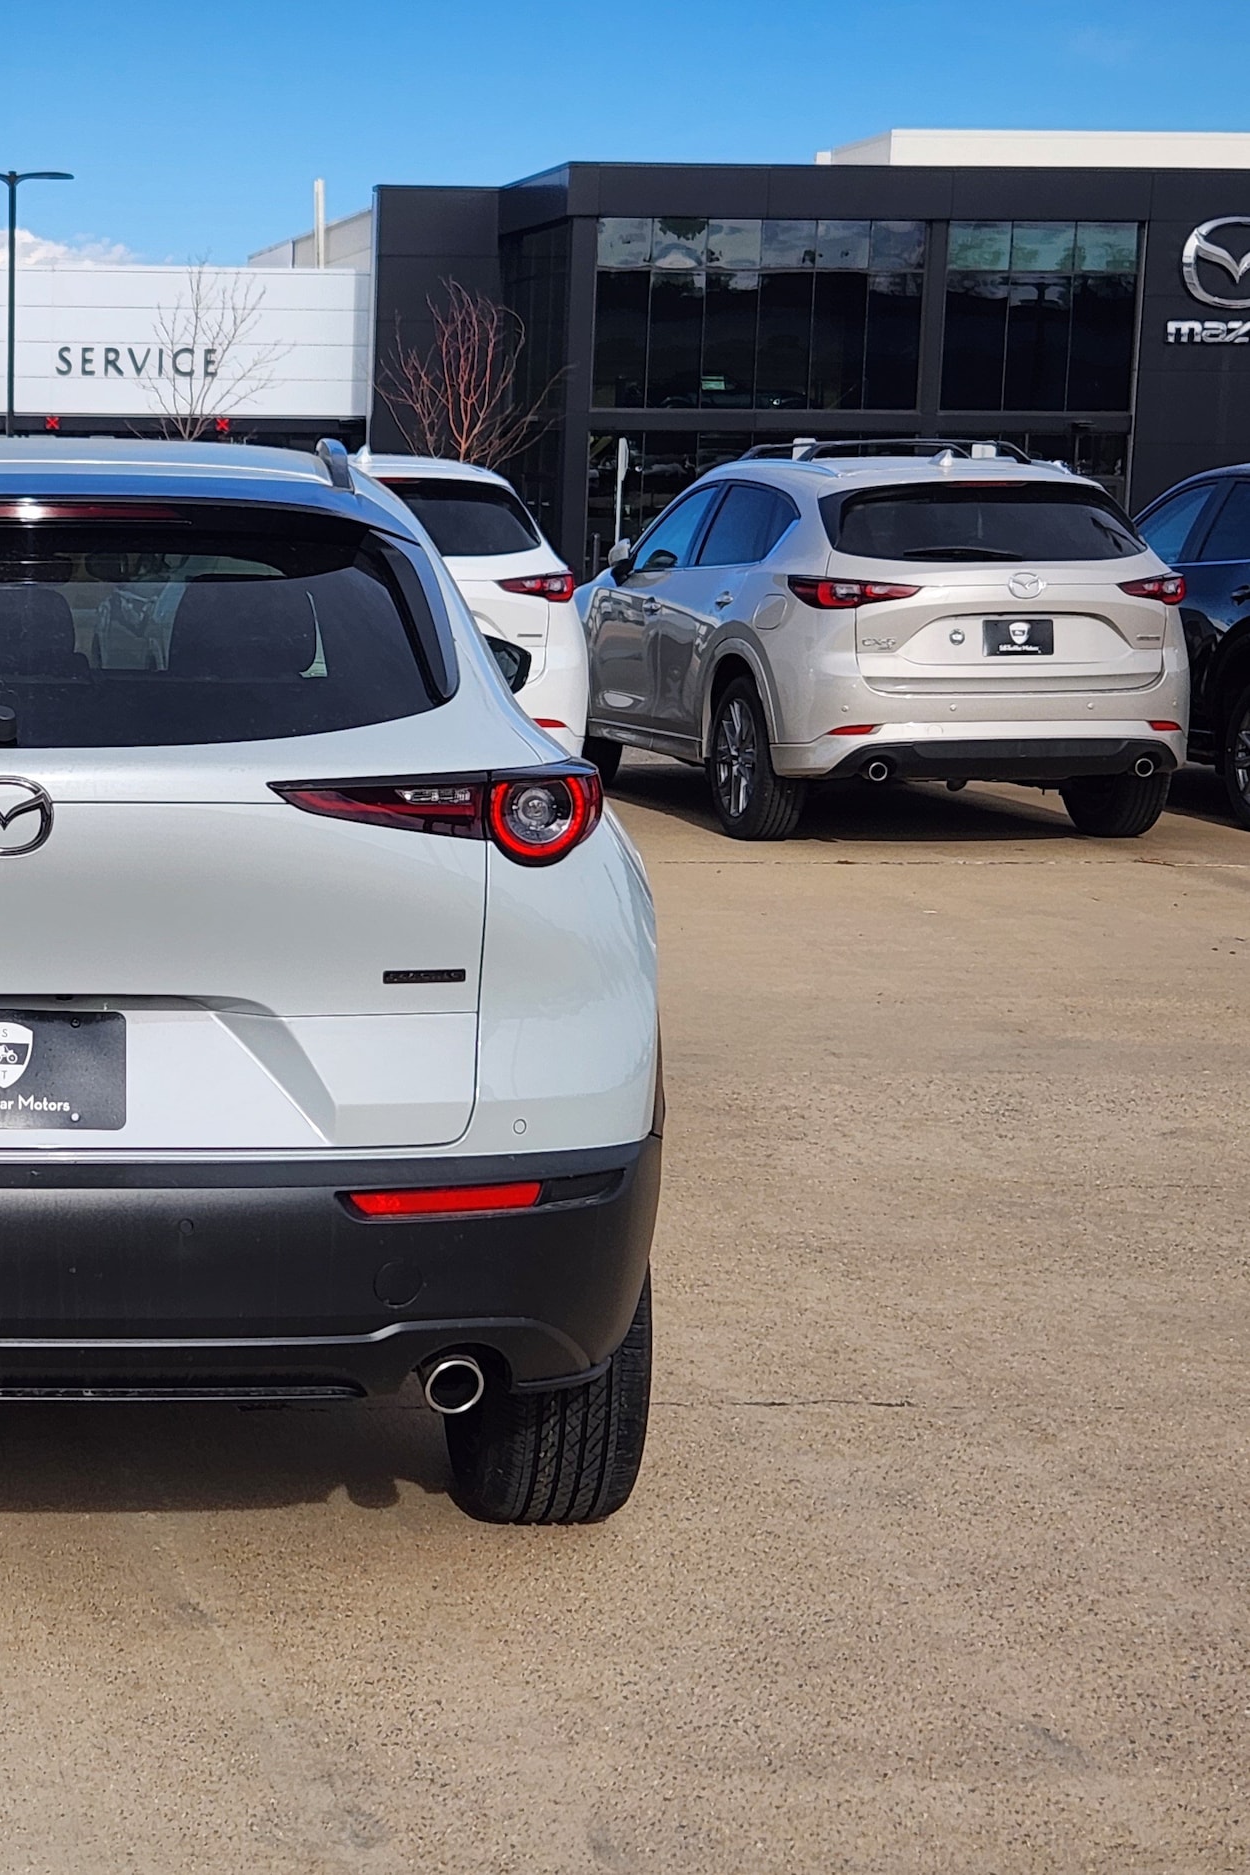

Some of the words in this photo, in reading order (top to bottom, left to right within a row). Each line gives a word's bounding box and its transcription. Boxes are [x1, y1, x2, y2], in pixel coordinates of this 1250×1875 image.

[55, 346, 218, 377] SERVICE
[1, 1028, 9, 1038] S
[1, 1070, 8, 1080] T
[18, 1094, 71, 1112] Motors
